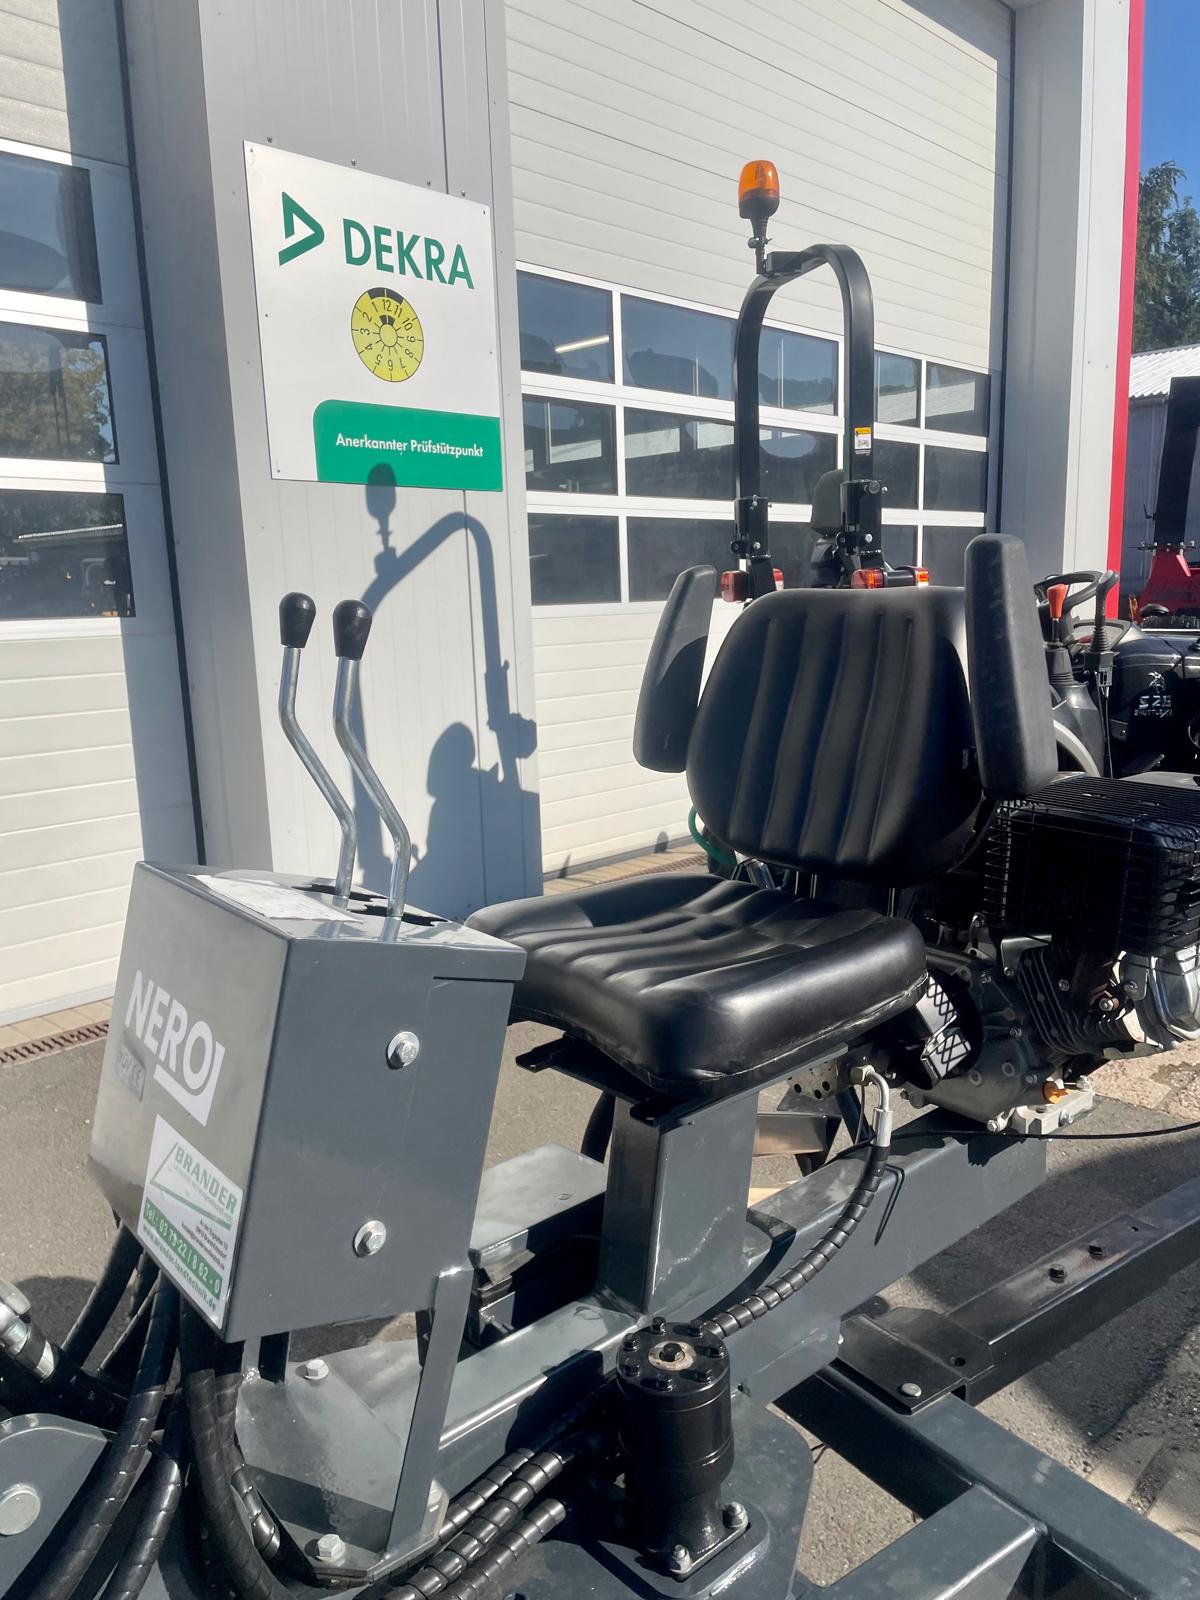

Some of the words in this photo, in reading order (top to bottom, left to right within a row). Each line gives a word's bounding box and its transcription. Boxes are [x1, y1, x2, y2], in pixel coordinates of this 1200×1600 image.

[343, 218, 475, 289] DEKRA
[371, 301, 379, 313] 1
[382, 299, 392, 312] 12
[394, 304, 403, 318] 11
[362, 311, 373, 322] 2
[402, 318, 413, 331] 10
[360, 327, 370, 336] 3
[406, 335, 416, 343] 9
[365, 343, 373, 351] 4
[404, 348, 414, 358] 8
[375, 354, 382, 365] 5
[387, 359, 393, 371] 6
[400, 357, 406, 369] 7
[335, 432, 408, 451] Anerkannter
[410, 439, 484, 459] Prüfstützpunkt
[124, 969, 213, 1090] NERO
[175, 1146, 237, 1215] BRANDER
[179, 1239, 188, 1259] 22
[198, 1263, 209, 1282] 62
